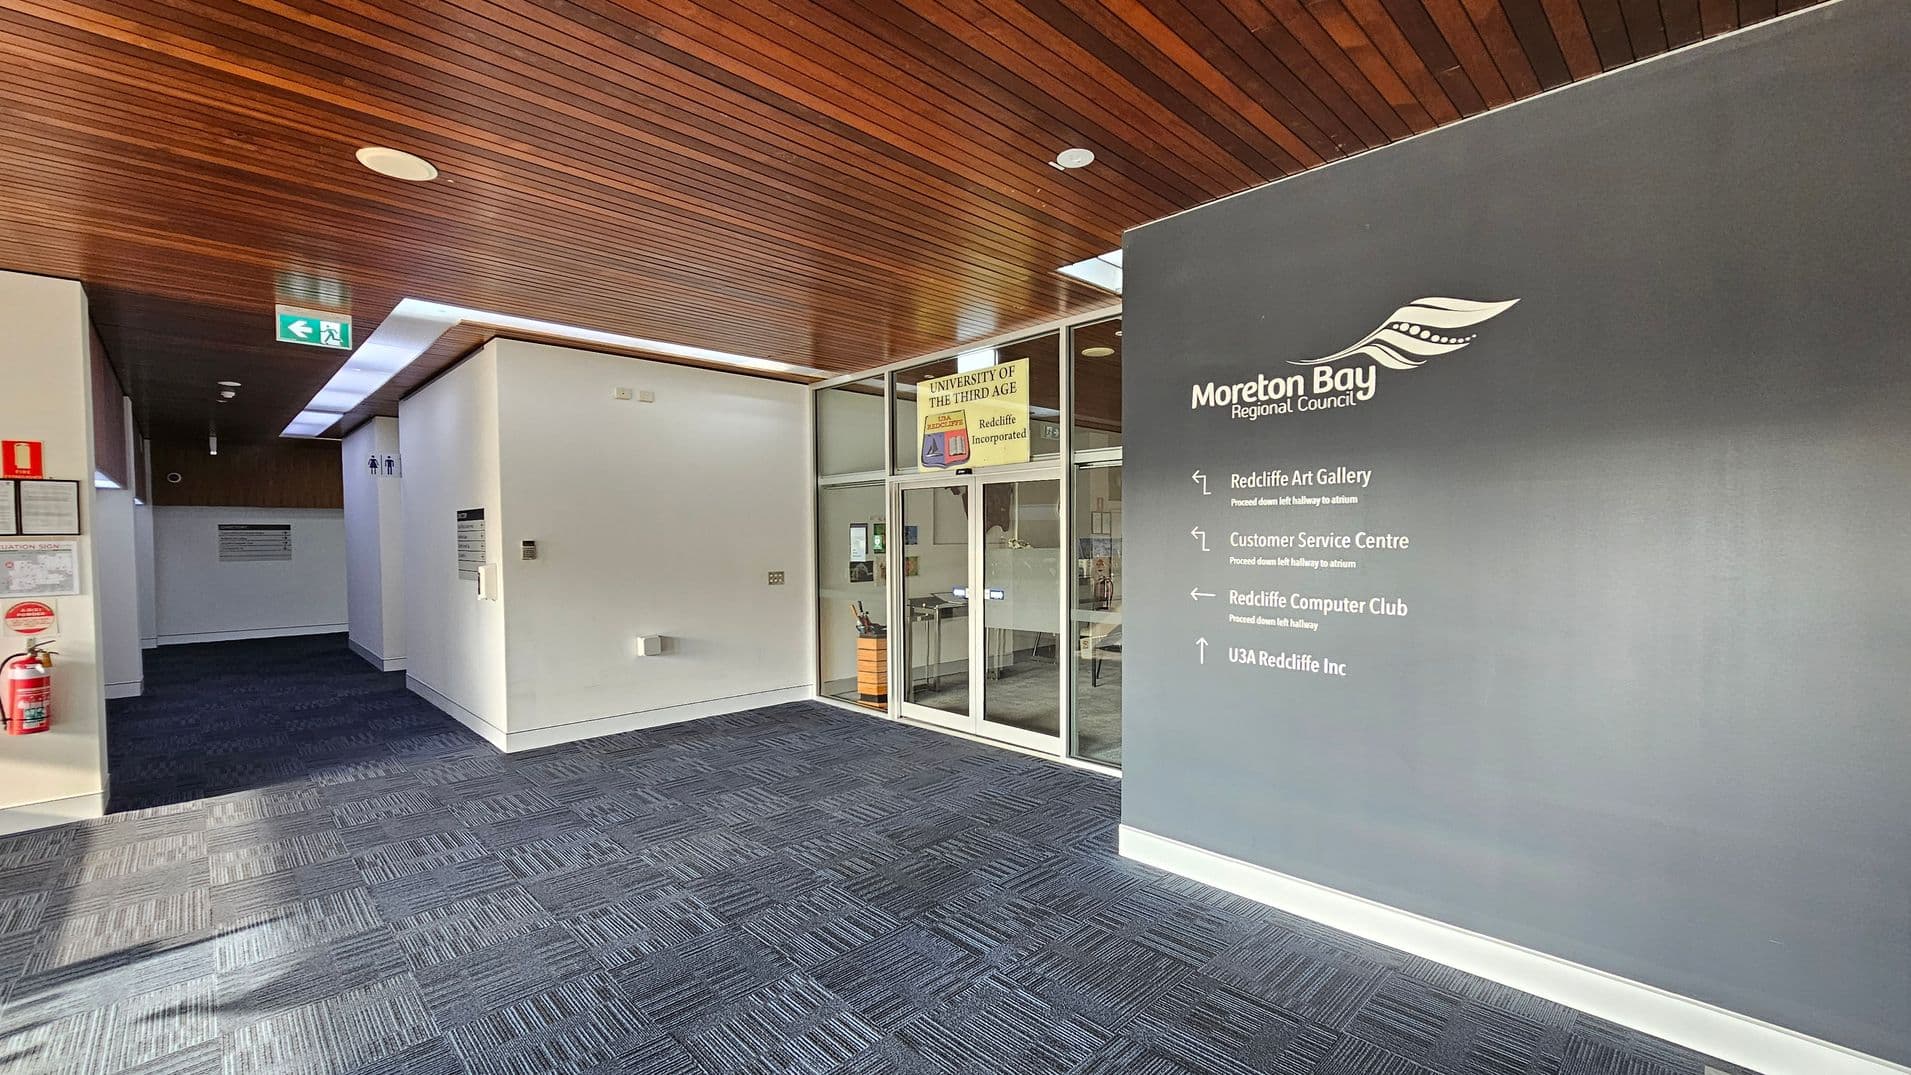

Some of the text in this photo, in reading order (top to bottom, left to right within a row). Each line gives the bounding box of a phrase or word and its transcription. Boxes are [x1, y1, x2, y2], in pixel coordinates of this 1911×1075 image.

[930, 365, 1015, 393] UNIVERSITY OF
[1191, 365, 1376, 409] Moreton Bay
[929, 381, 1017, 408] THE THIRD AGE
[1231, 391, 1357, 421] Regional Council
[979, 414, 1016, 429] Redcliffe
[972, 428, 1027, 445] Incorporated
[1231, 467, 1372, 489] Redcliffe Art Gallery
[1230, 495, 1358, 507] Proceed down left hallway to atrium
[1230, 531, 1409, 549] Customer Service Centre
[1229, 556, 1356, 569] Proceed down left hallway to atrium
[1229, 590, 1408, 616] Redcliffe Computer Club
[1229, 614, 1318, 631] Proceed down left hallway
[1228, 647, 1347, 676] U3A Redcliffe Inc
